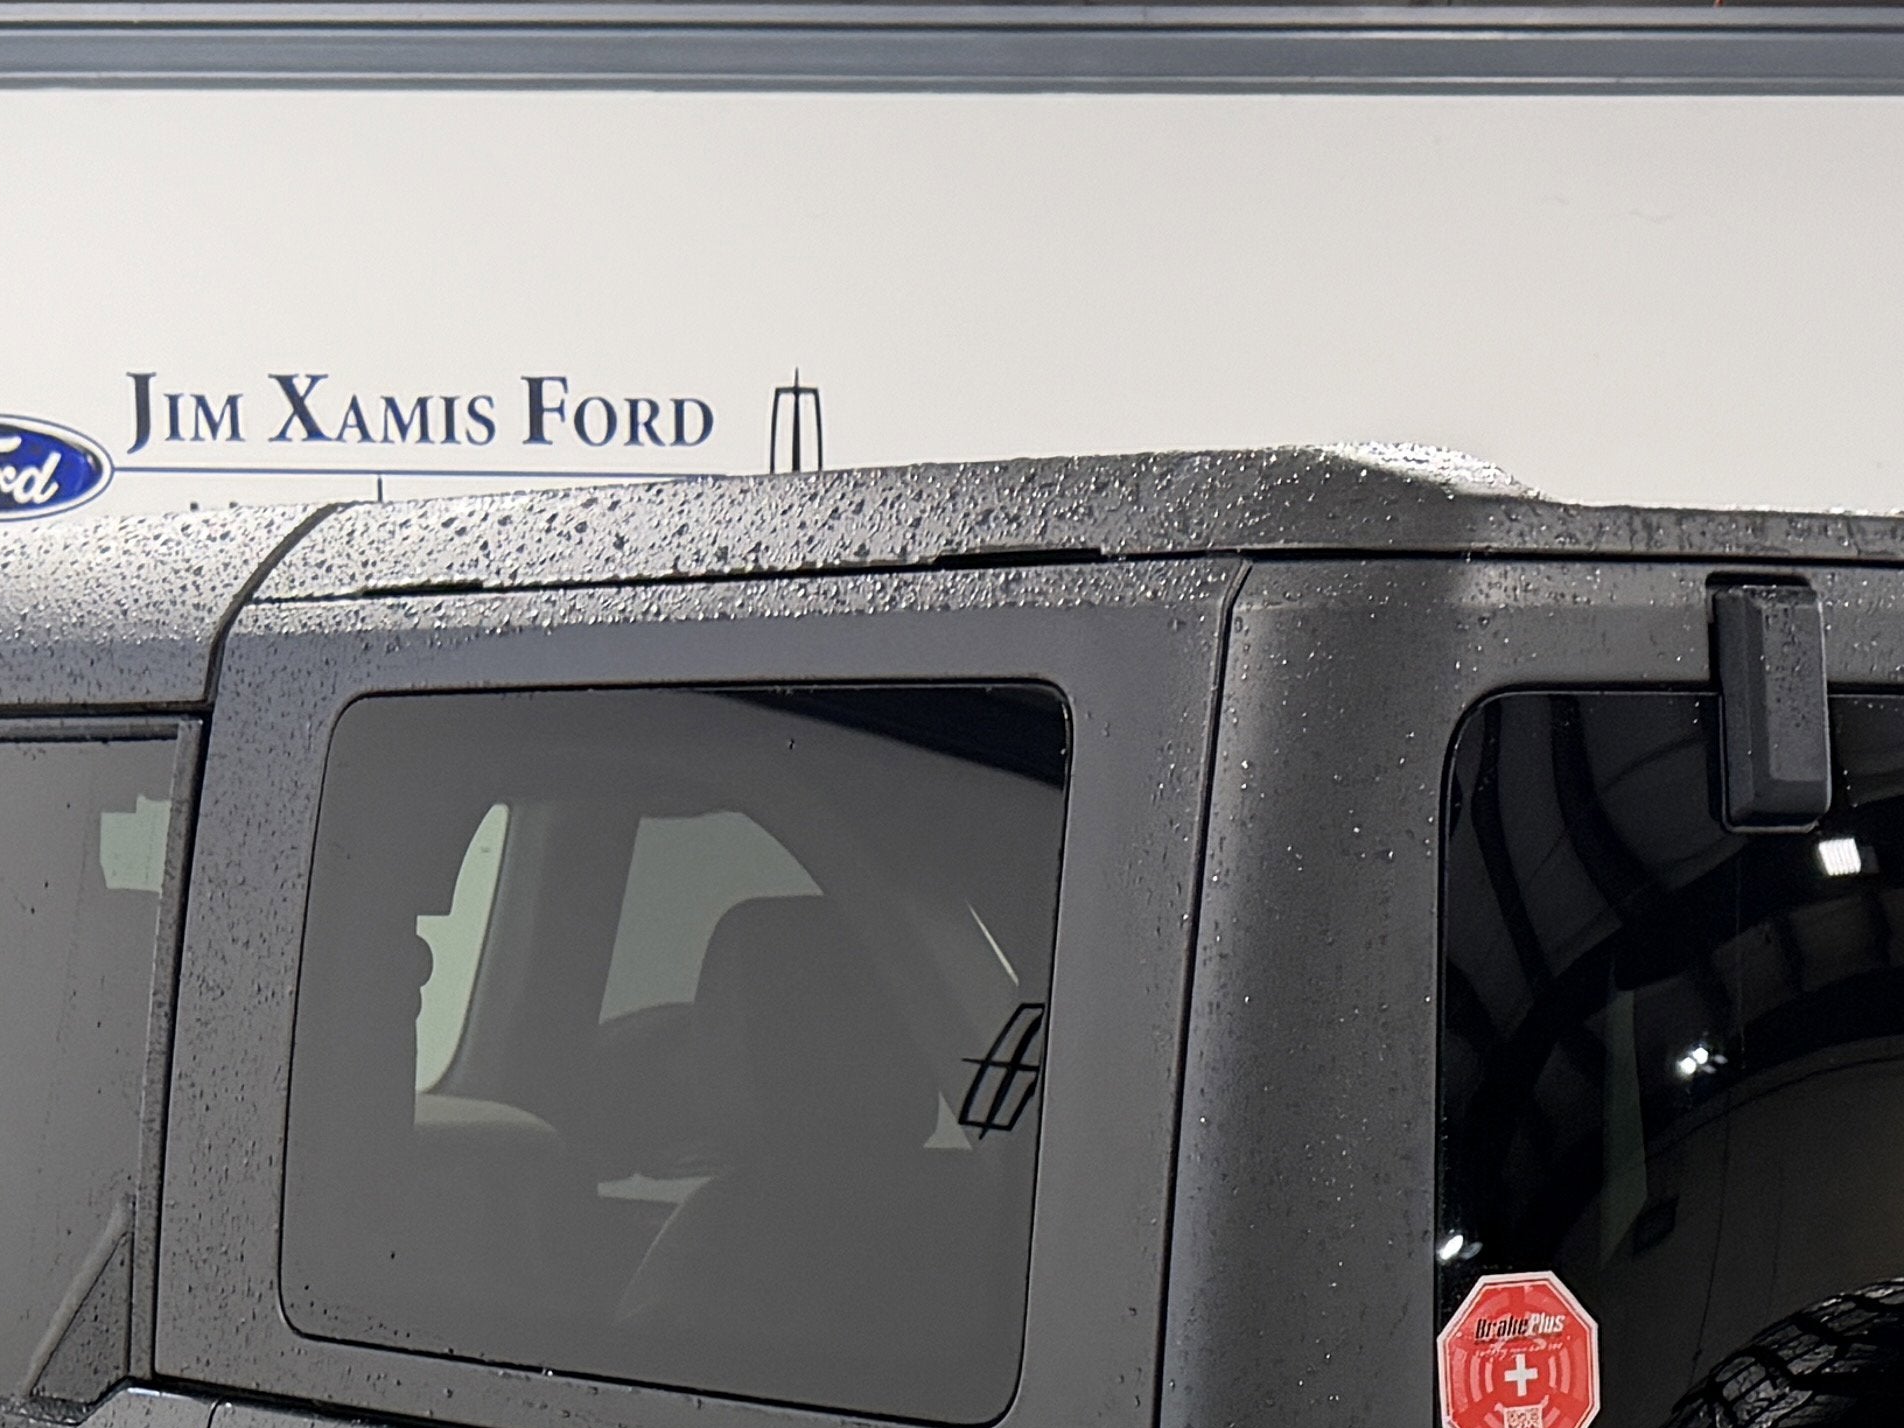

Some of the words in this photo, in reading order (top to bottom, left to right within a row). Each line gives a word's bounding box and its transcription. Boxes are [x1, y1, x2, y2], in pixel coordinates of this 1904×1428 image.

[127, 372, 243, 454] JIM
[268, 374, 497, 446] XAMIS
[521, 376, 715, 447] FORD
